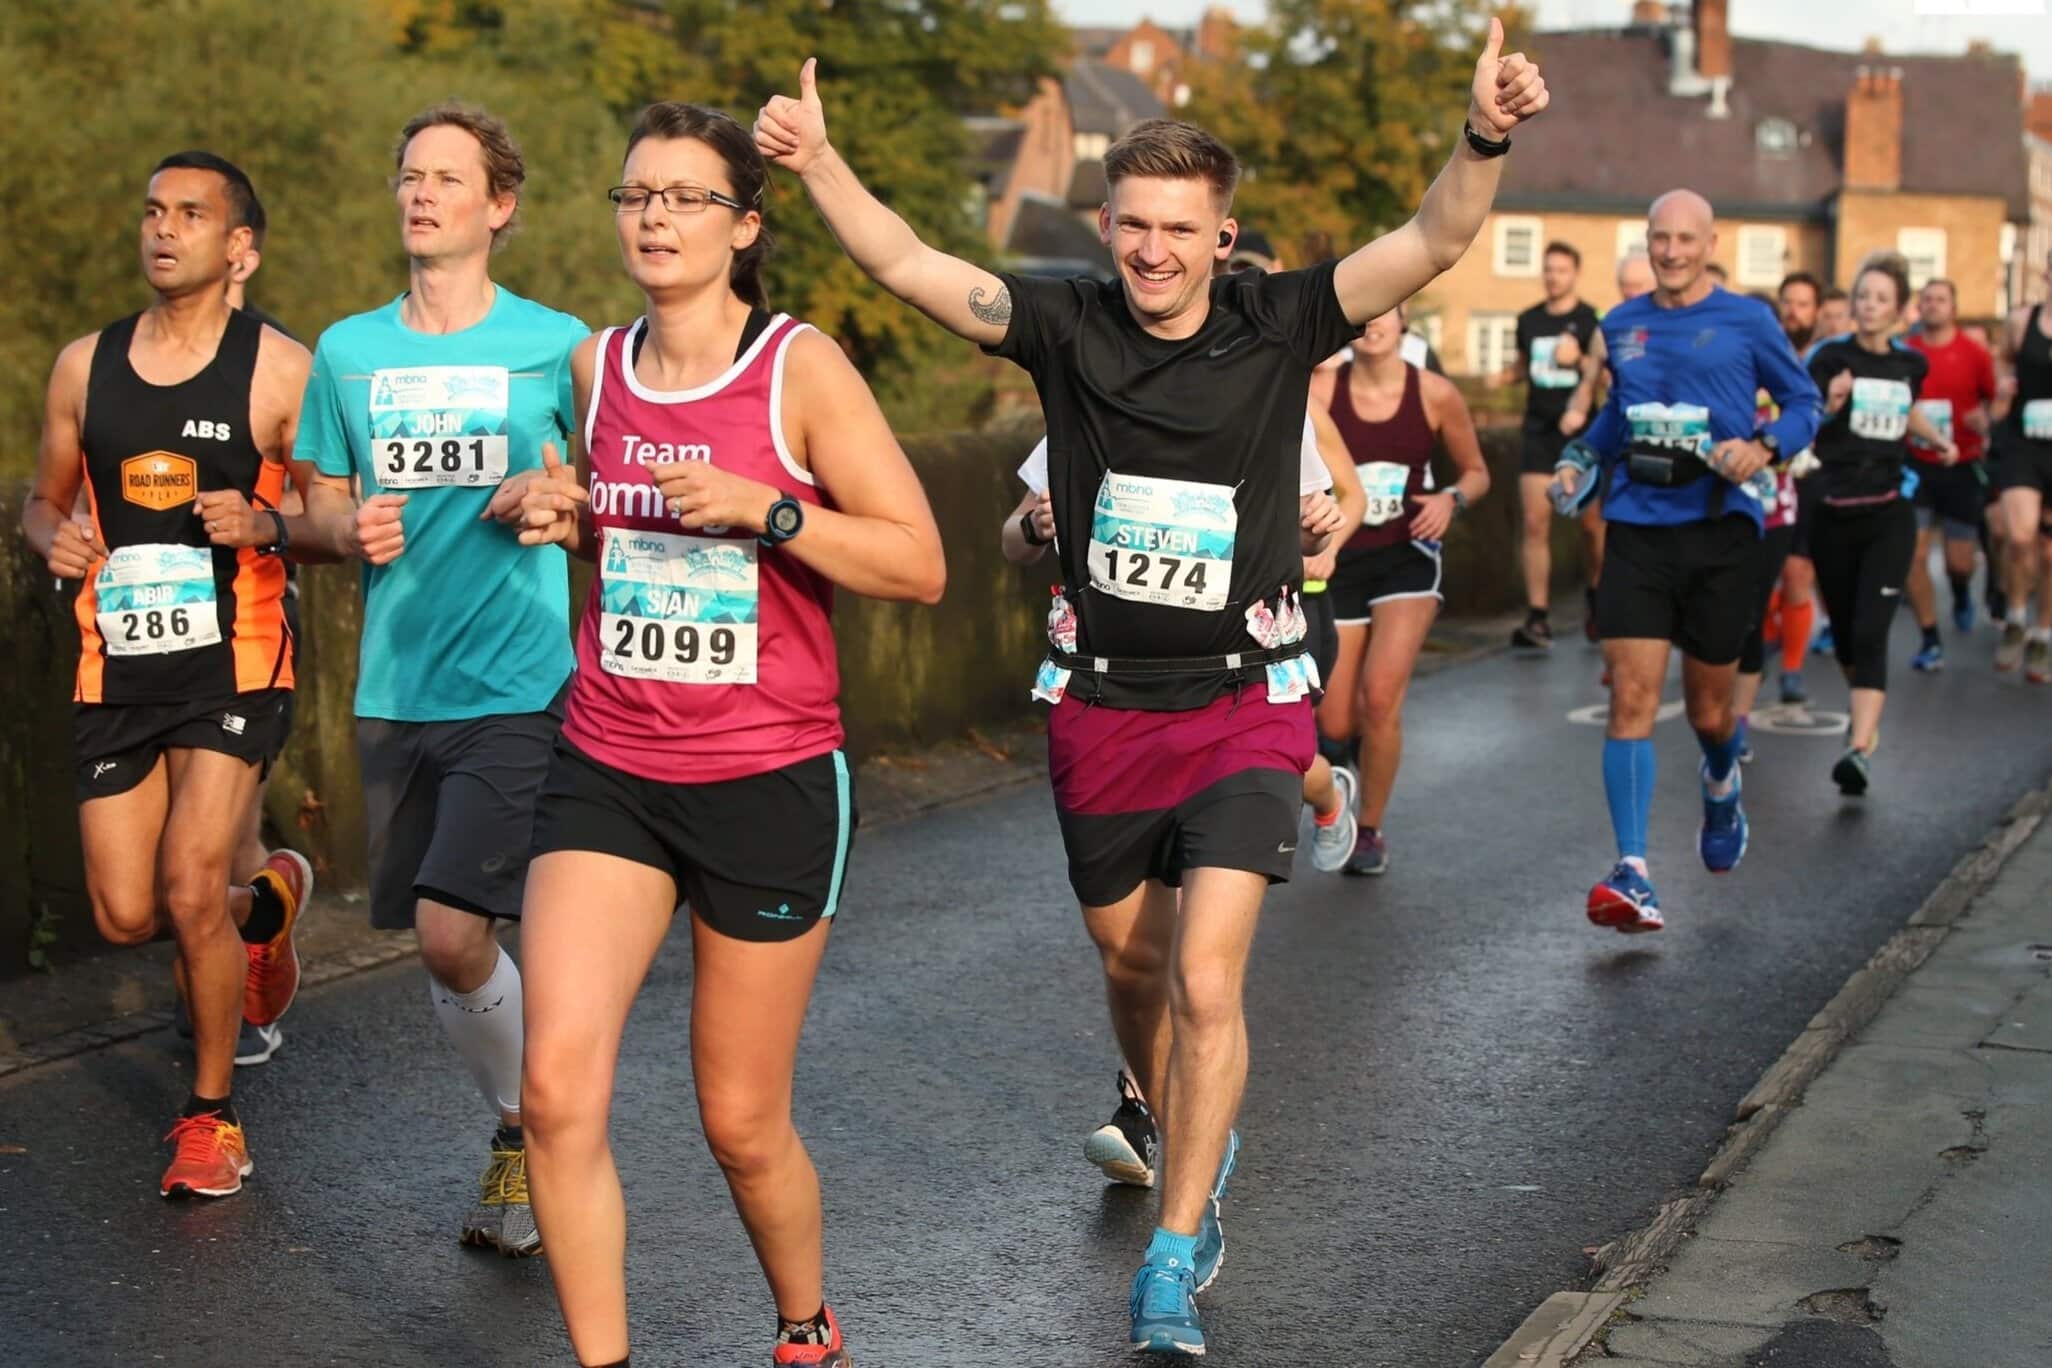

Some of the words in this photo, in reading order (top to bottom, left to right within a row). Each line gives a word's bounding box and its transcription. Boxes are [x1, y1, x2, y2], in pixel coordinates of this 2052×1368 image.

[181, 419, 231, 441] ABS
[411, 412, 462, 433] JOHN
[386, 439, 484, 473] 3281
[621, 435, 712, 466] Team
[128, 473, 152, 488] ROAD
[153, 472, 191, 488] RUNNERS
[1115, 481, 1153, 497] mbna
[628, 537, 665, 553] mbna
[1116, 523, 1199, 554] STEVEN
[1104, 549, 1207, 594] 1274
[132, 585, 175, 606] ABIR
[647, 589, 699, 617] SIAN
[122, 607, 190, 641] 286
[614, 618, 736, 665] 2099
